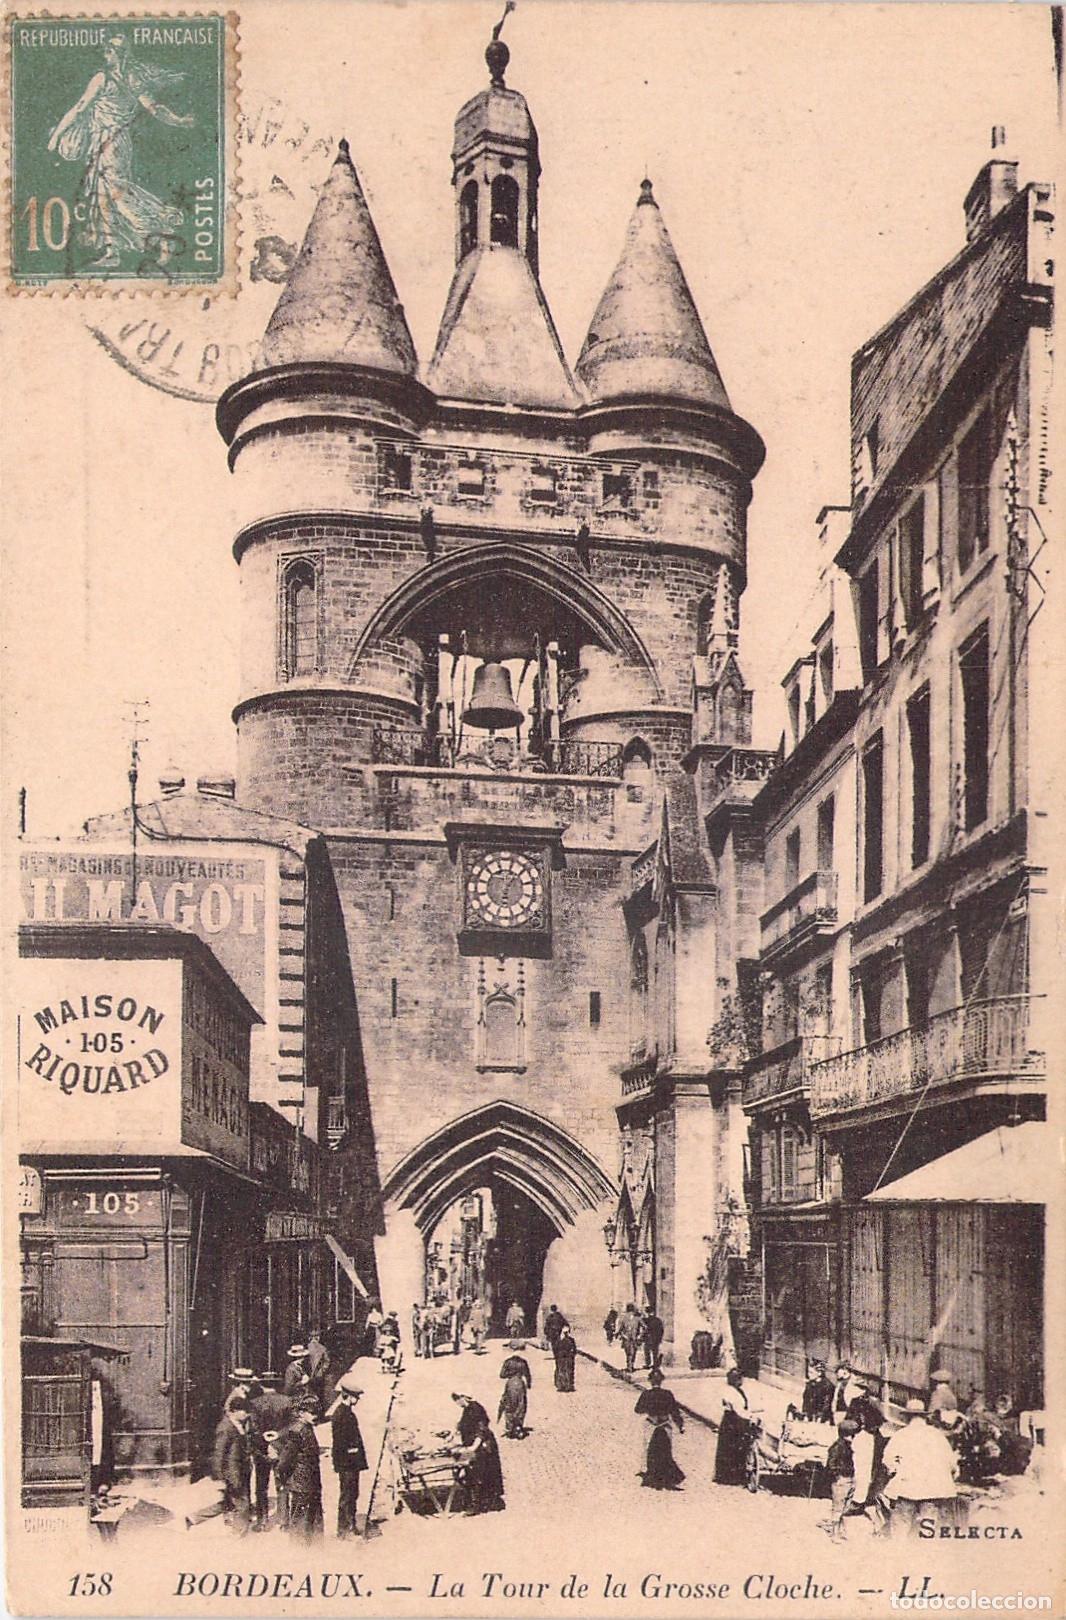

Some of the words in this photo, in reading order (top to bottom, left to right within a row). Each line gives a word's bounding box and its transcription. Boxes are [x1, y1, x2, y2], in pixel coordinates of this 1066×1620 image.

[133, 27, 214, 46] FRANÇAISE
[195, 178, 214, 261] POSTES
[87, 880, 264, 935] MAGOT
[34, 994, 165, 1034] MAISON
[25, 1043, 169, 1095] RIQUARD
